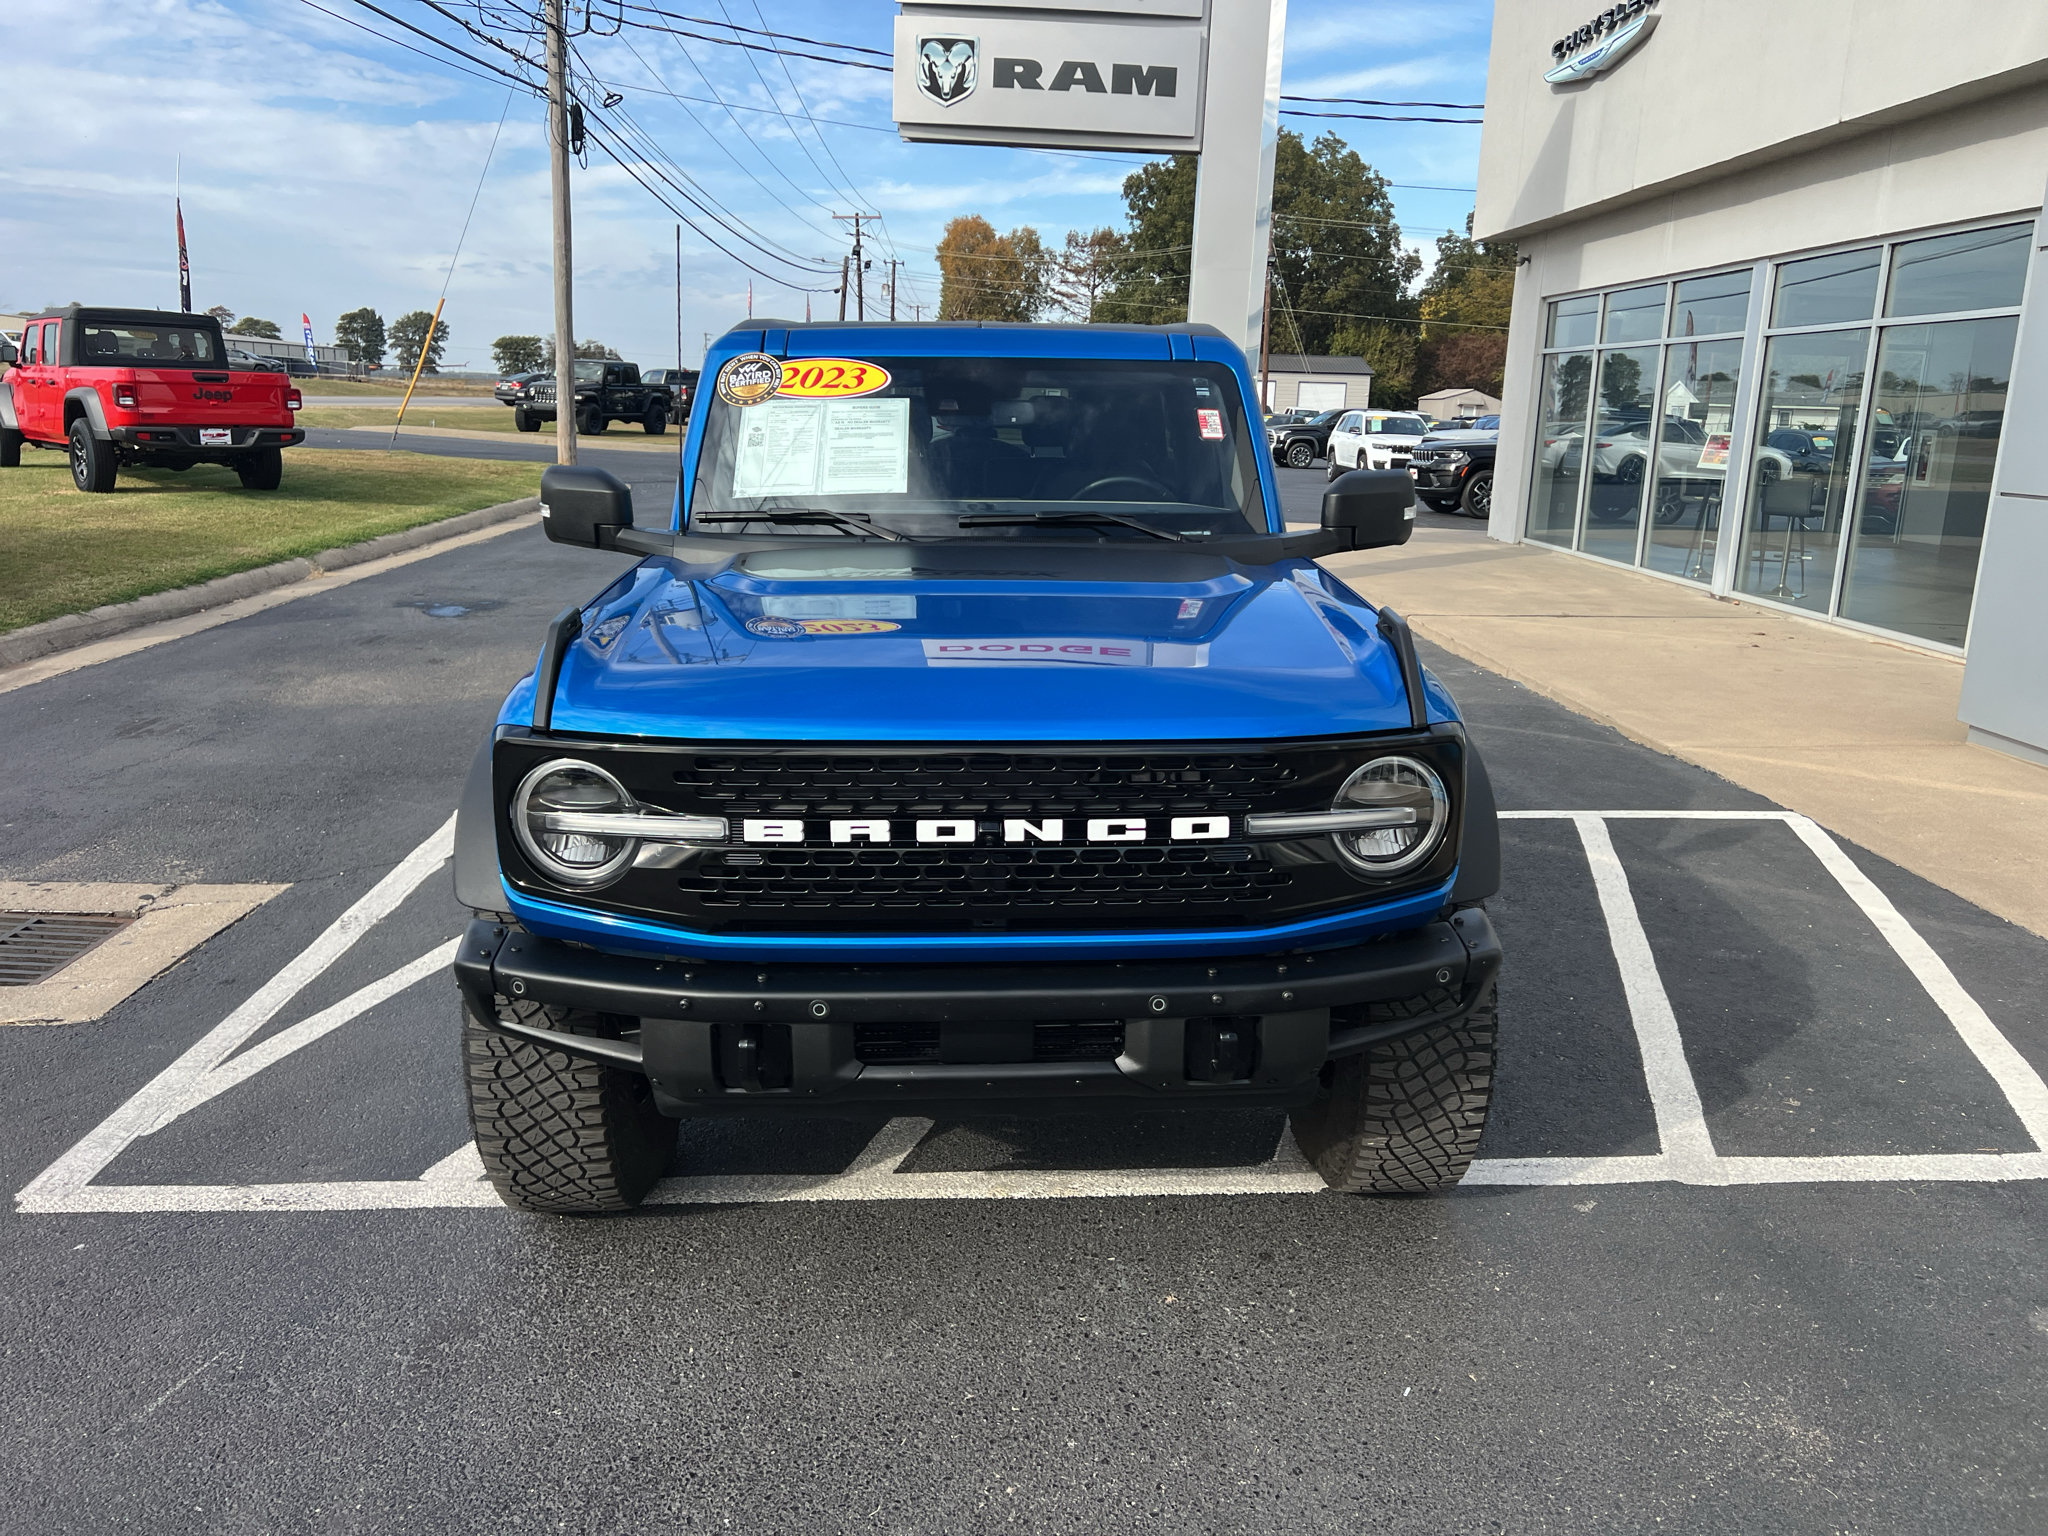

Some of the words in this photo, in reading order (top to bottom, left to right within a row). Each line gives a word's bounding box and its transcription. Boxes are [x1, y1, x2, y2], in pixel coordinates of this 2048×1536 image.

[992, 57, 1178, 98] RAM
[729, 370, 771, 383] BAYIRD
[729, 378, 771, 388] CERTIFIED
[781, 366, 868, 389] 2023
[193, 387, 232, 402] Jeep
[743, 815, 1230, 843] BRONCO
